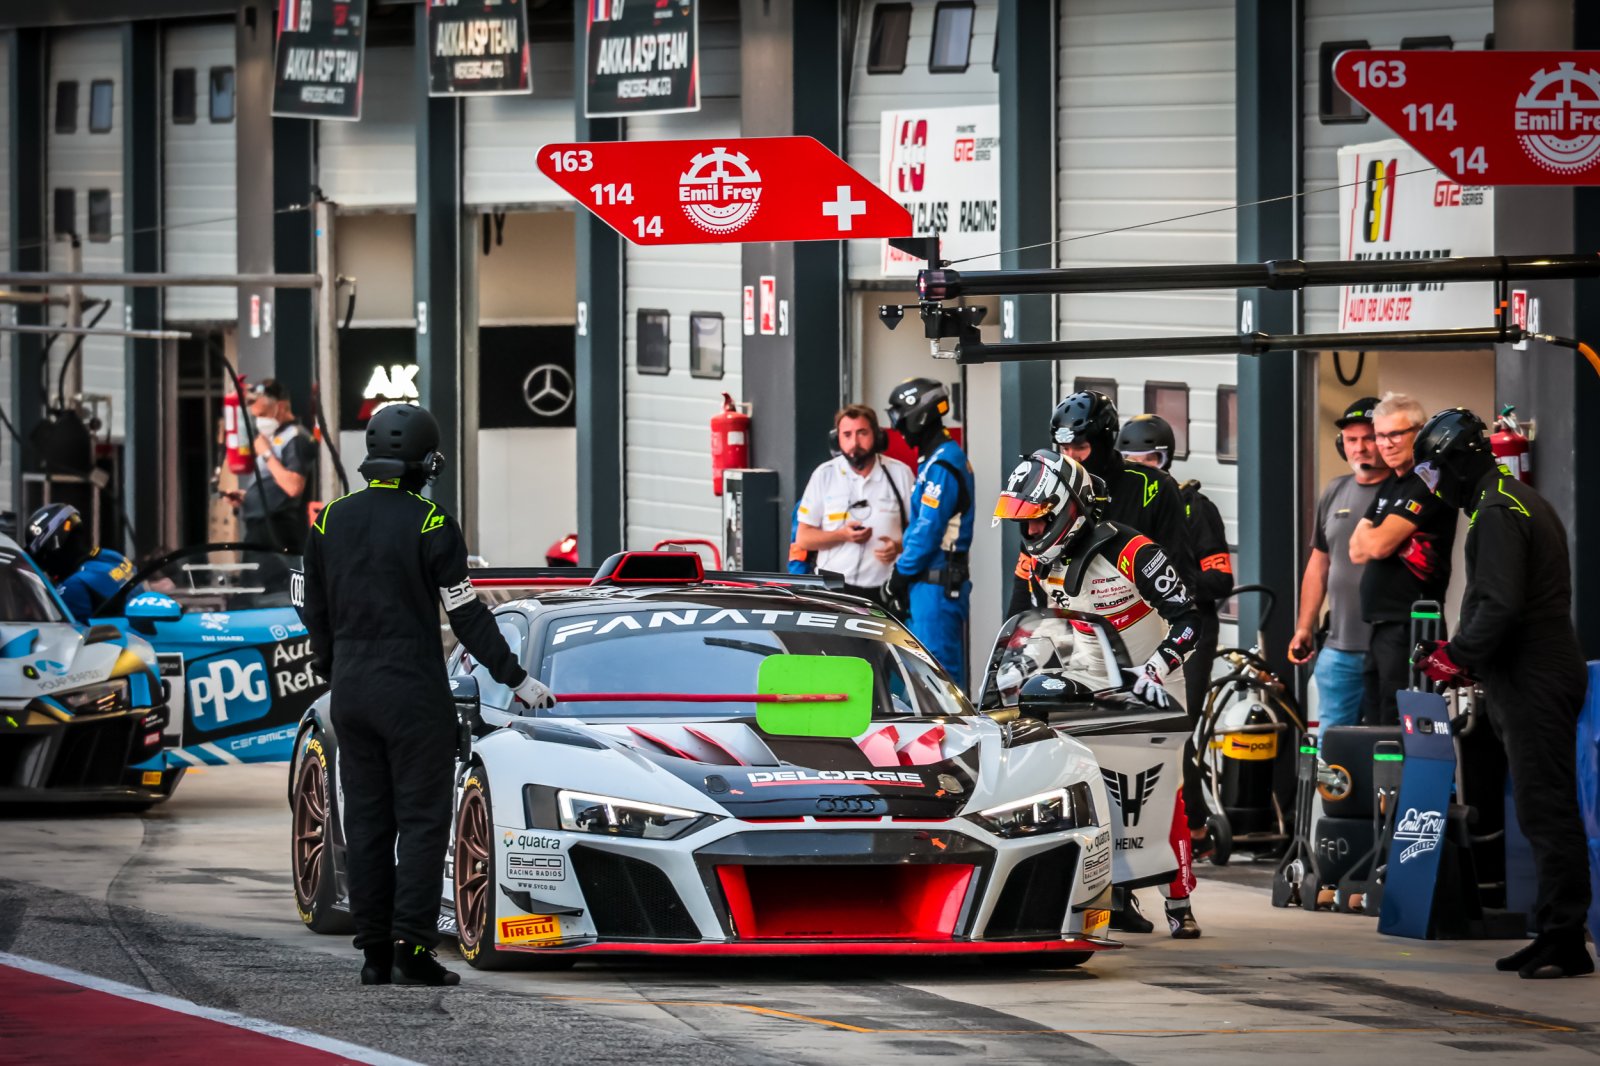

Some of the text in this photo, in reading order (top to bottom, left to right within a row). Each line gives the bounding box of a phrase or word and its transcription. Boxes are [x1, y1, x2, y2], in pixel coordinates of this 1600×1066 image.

[435, 19, 518, 56] AKKA ASP TEAM
[597, 31, 688, 75] AKKA ASP TEAM
[284, 48, 358, 83] AKKA ASP TEAM
[1352, 60, 1407, 88] 163
[1402, 103, 1457, 132] 114
[1515, 110, 1600, 131] Emil Fre
[953, 138, 974, 161] GT2
[1450, 146, 1488, 175] 14
[549, 150, 594, 172] 163
[590, 183, 635, 205] 114
[679, 184, 763, 202] Emil Frey
[1362, 158, 1398, 243] 81
[1433, 181, 1462, 207] GT2
[632, 216, 664, 238] 14
[917, 202, 949, 233] CLASS
[959, 200, 998, 233] RACING
[1348, 301, 1364, 322] AUDI
[1377, 299, 1394, 322] LMS
[1395, 297, 1412, 321] GT2
[552, 609, 887, 646] FANATEC
[747, 770, 923, 783] DELORGE
[518, 834, 561, 850] quatra
[1115, 837, 1145, 850] HEINZ
[509, 856, 562, 868] SYCO
[509, 868, 563, 878] RACING RADIOS
[517, 882, 557, 891] WWW.SYCO.EU
[501, 916, 554, 938] PIRELLI
[1085, 909, 1109, 930] PIRELLI
